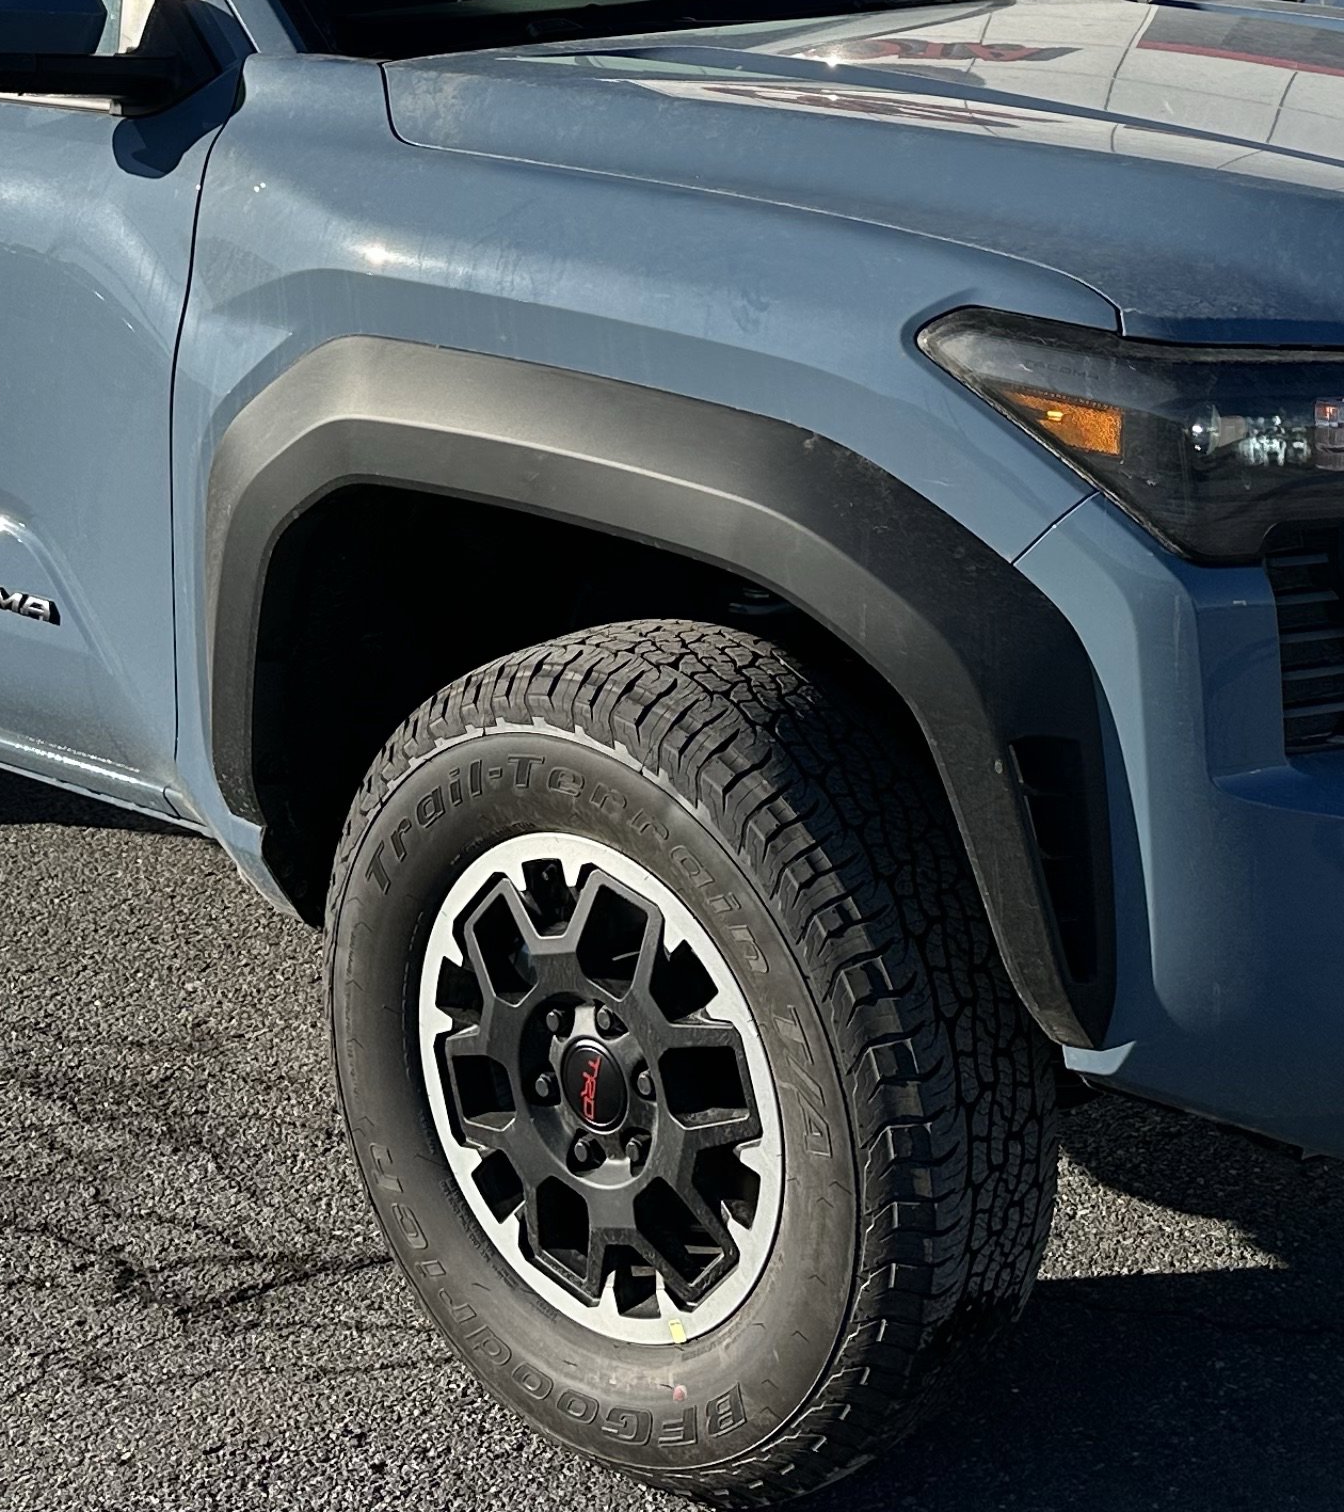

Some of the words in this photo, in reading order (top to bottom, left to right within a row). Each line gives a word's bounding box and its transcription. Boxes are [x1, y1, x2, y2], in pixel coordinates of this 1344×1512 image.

[364, 753, 771, 975] Trail-Terrain
[772, 1003, 834, 1159] T/A
[580, 1055, 602, 1120] TRD
[368, 1142, 748, 1448] BFGoodrich
